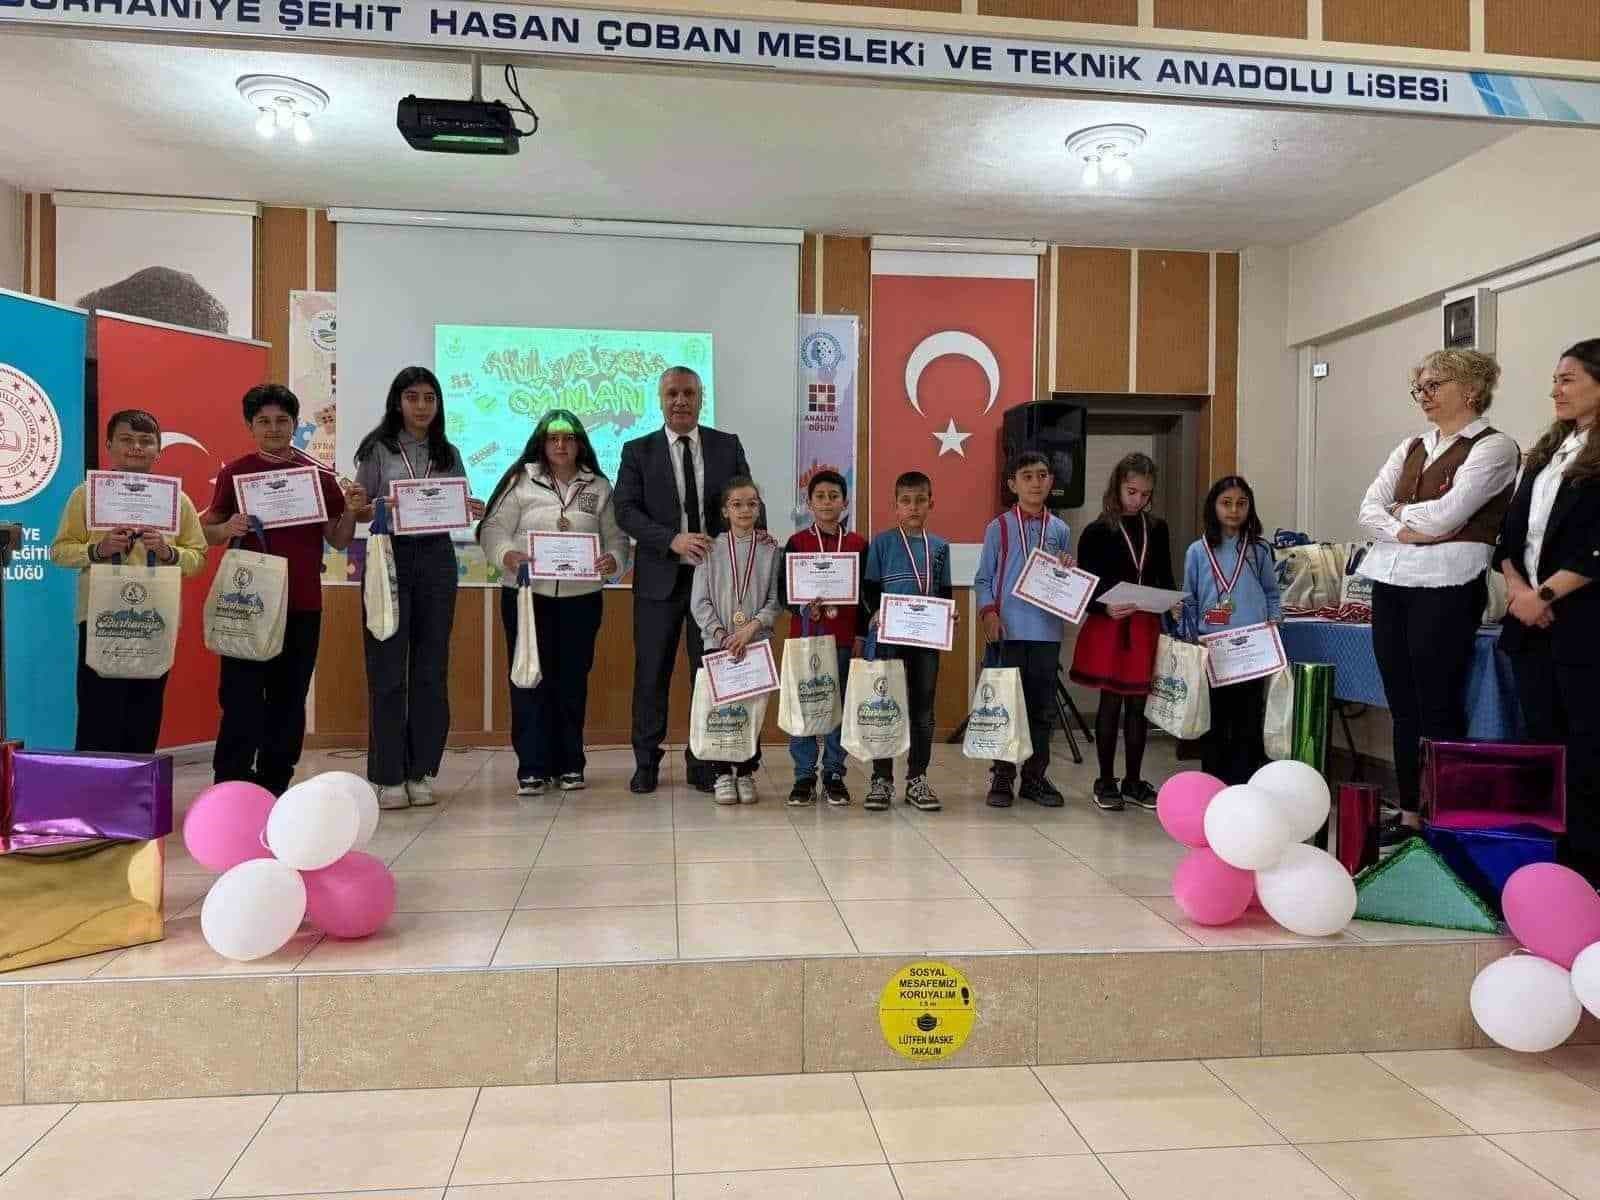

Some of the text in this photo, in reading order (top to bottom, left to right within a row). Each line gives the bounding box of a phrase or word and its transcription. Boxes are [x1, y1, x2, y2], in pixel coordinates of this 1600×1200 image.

[430, 9, 579, 43] HASAN
[597, 20, 740, 52] ÇOBAN
[944, 44, 992, 70] VE
[1156, 58, 1332, 94] ANADOLU
[909, 967, 947, 977] SOSYAL
[899, 978, 958, 988] MESAFEMİZİ
[900, 990, 956, 999] KORUYALIM
[898, 1034, 954, 1045] LÜTFEN MASKE
[911, 1047, 942, 1056] TAKALIM
